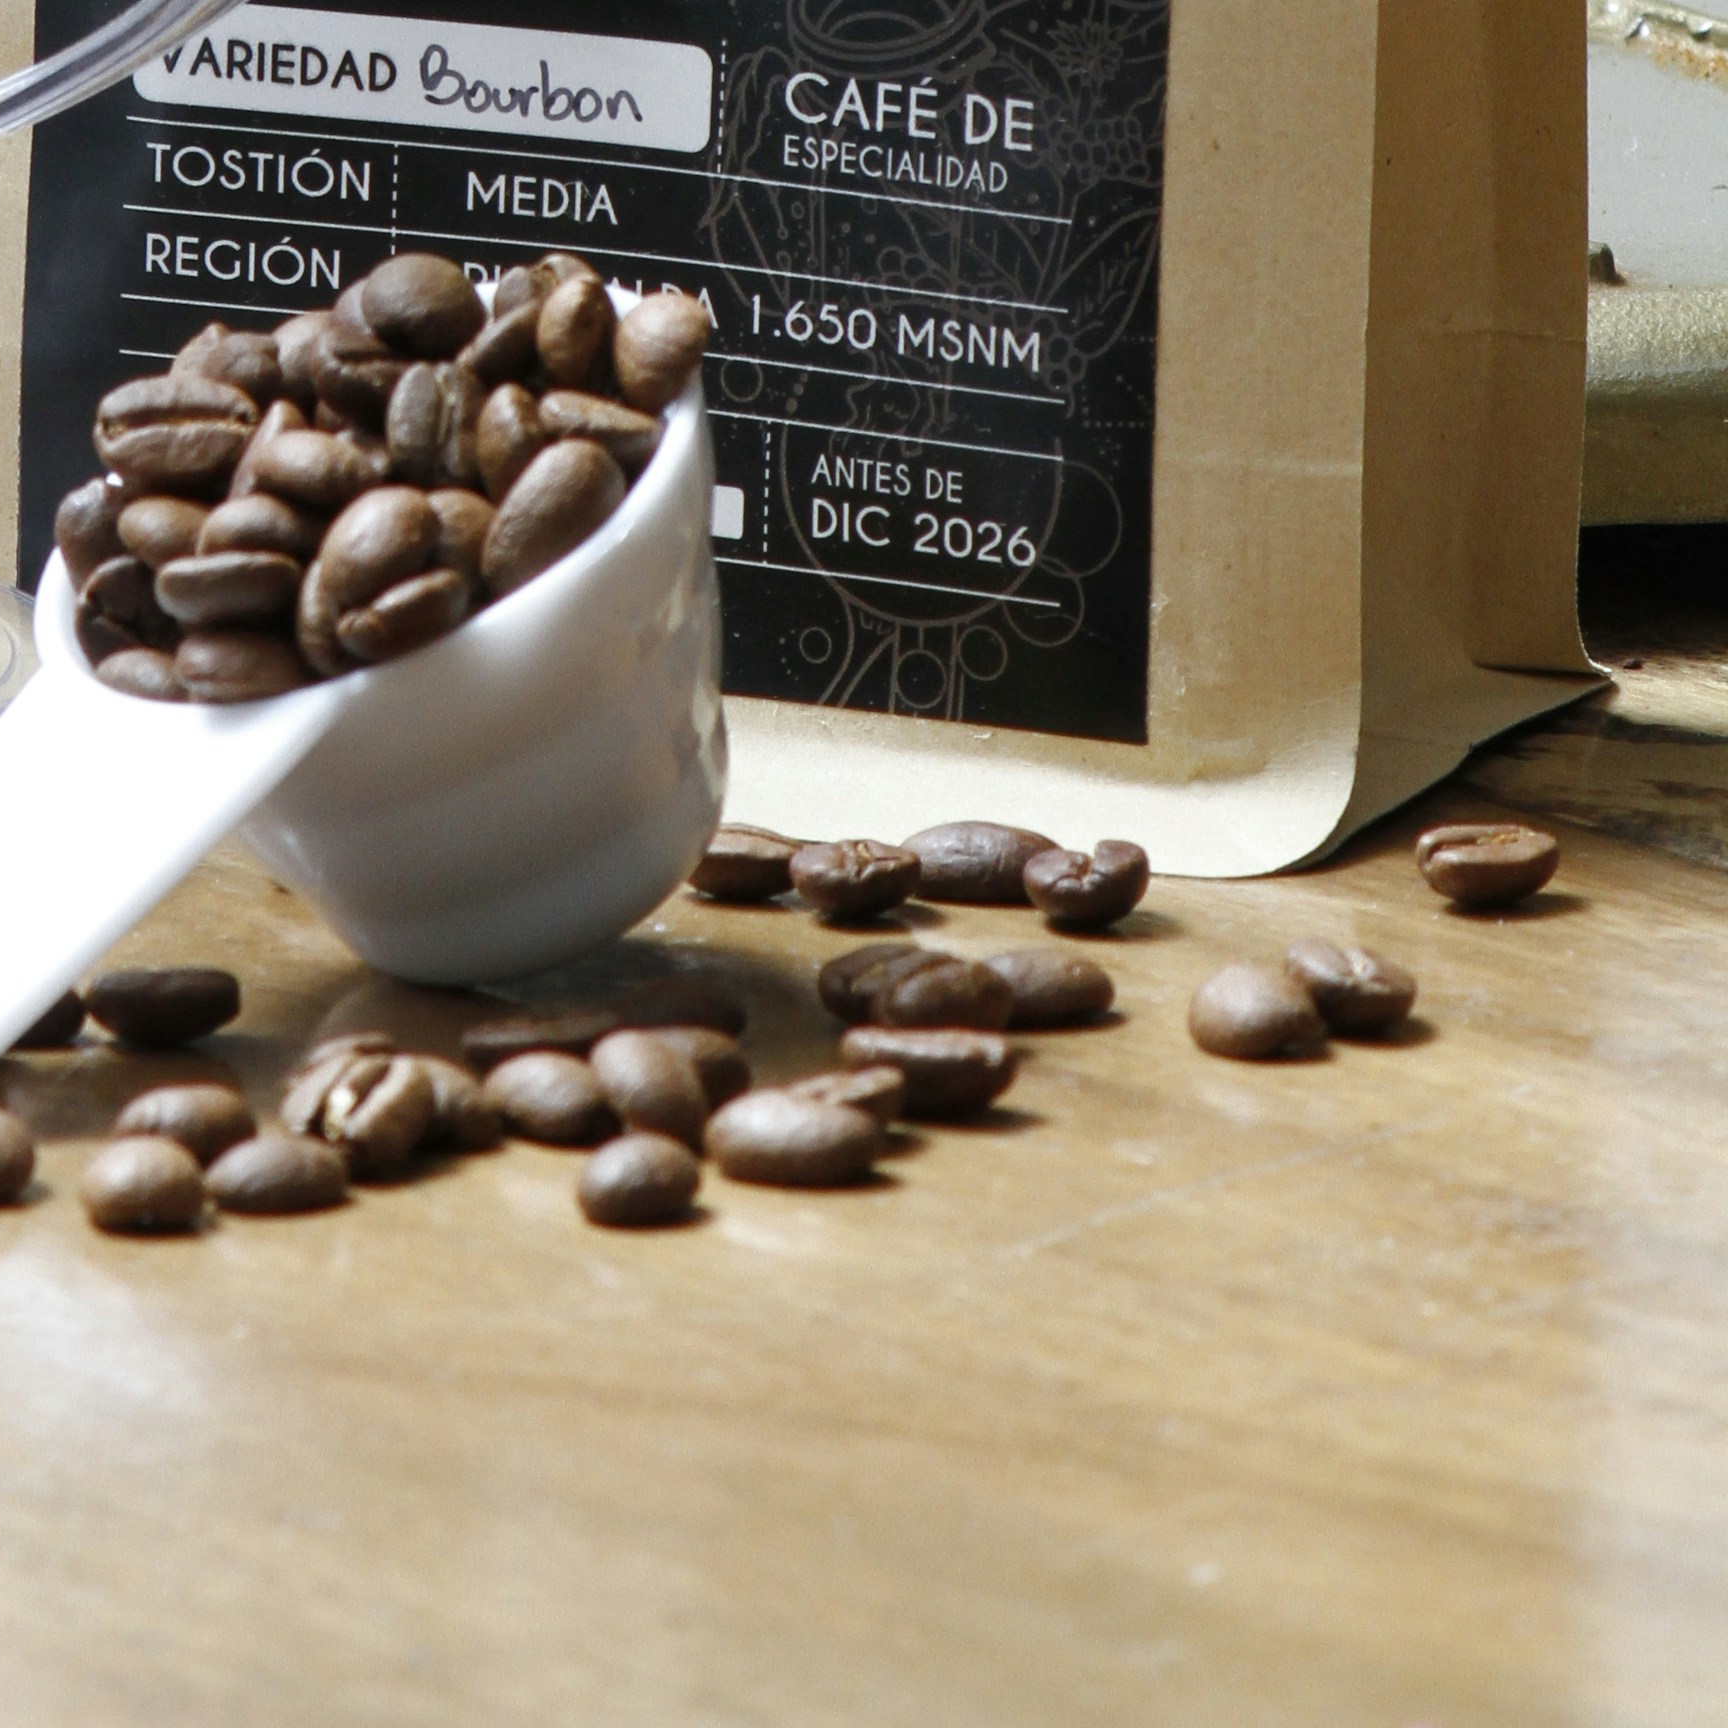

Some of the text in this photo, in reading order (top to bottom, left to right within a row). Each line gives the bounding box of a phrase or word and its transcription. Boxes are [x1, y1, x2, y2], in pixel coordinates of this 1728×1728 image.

[418, 43, 644, 123] Bourbon
[784, 71, 1035, 152] CAFÉ DE
[145, 141, 619, 226] TOSTIÓN MEDIA
[782, 133, 1009, 194] ESPECIALIDAD
[144, 231, 341, 290] REGIÓN
[751, 294, 877, 350] 1.650
[897, 313, 1041, 373] MSNM
[810, 453, 964, 504] ANTES DE
[811, 497, 1037, 568] DIC 2026
